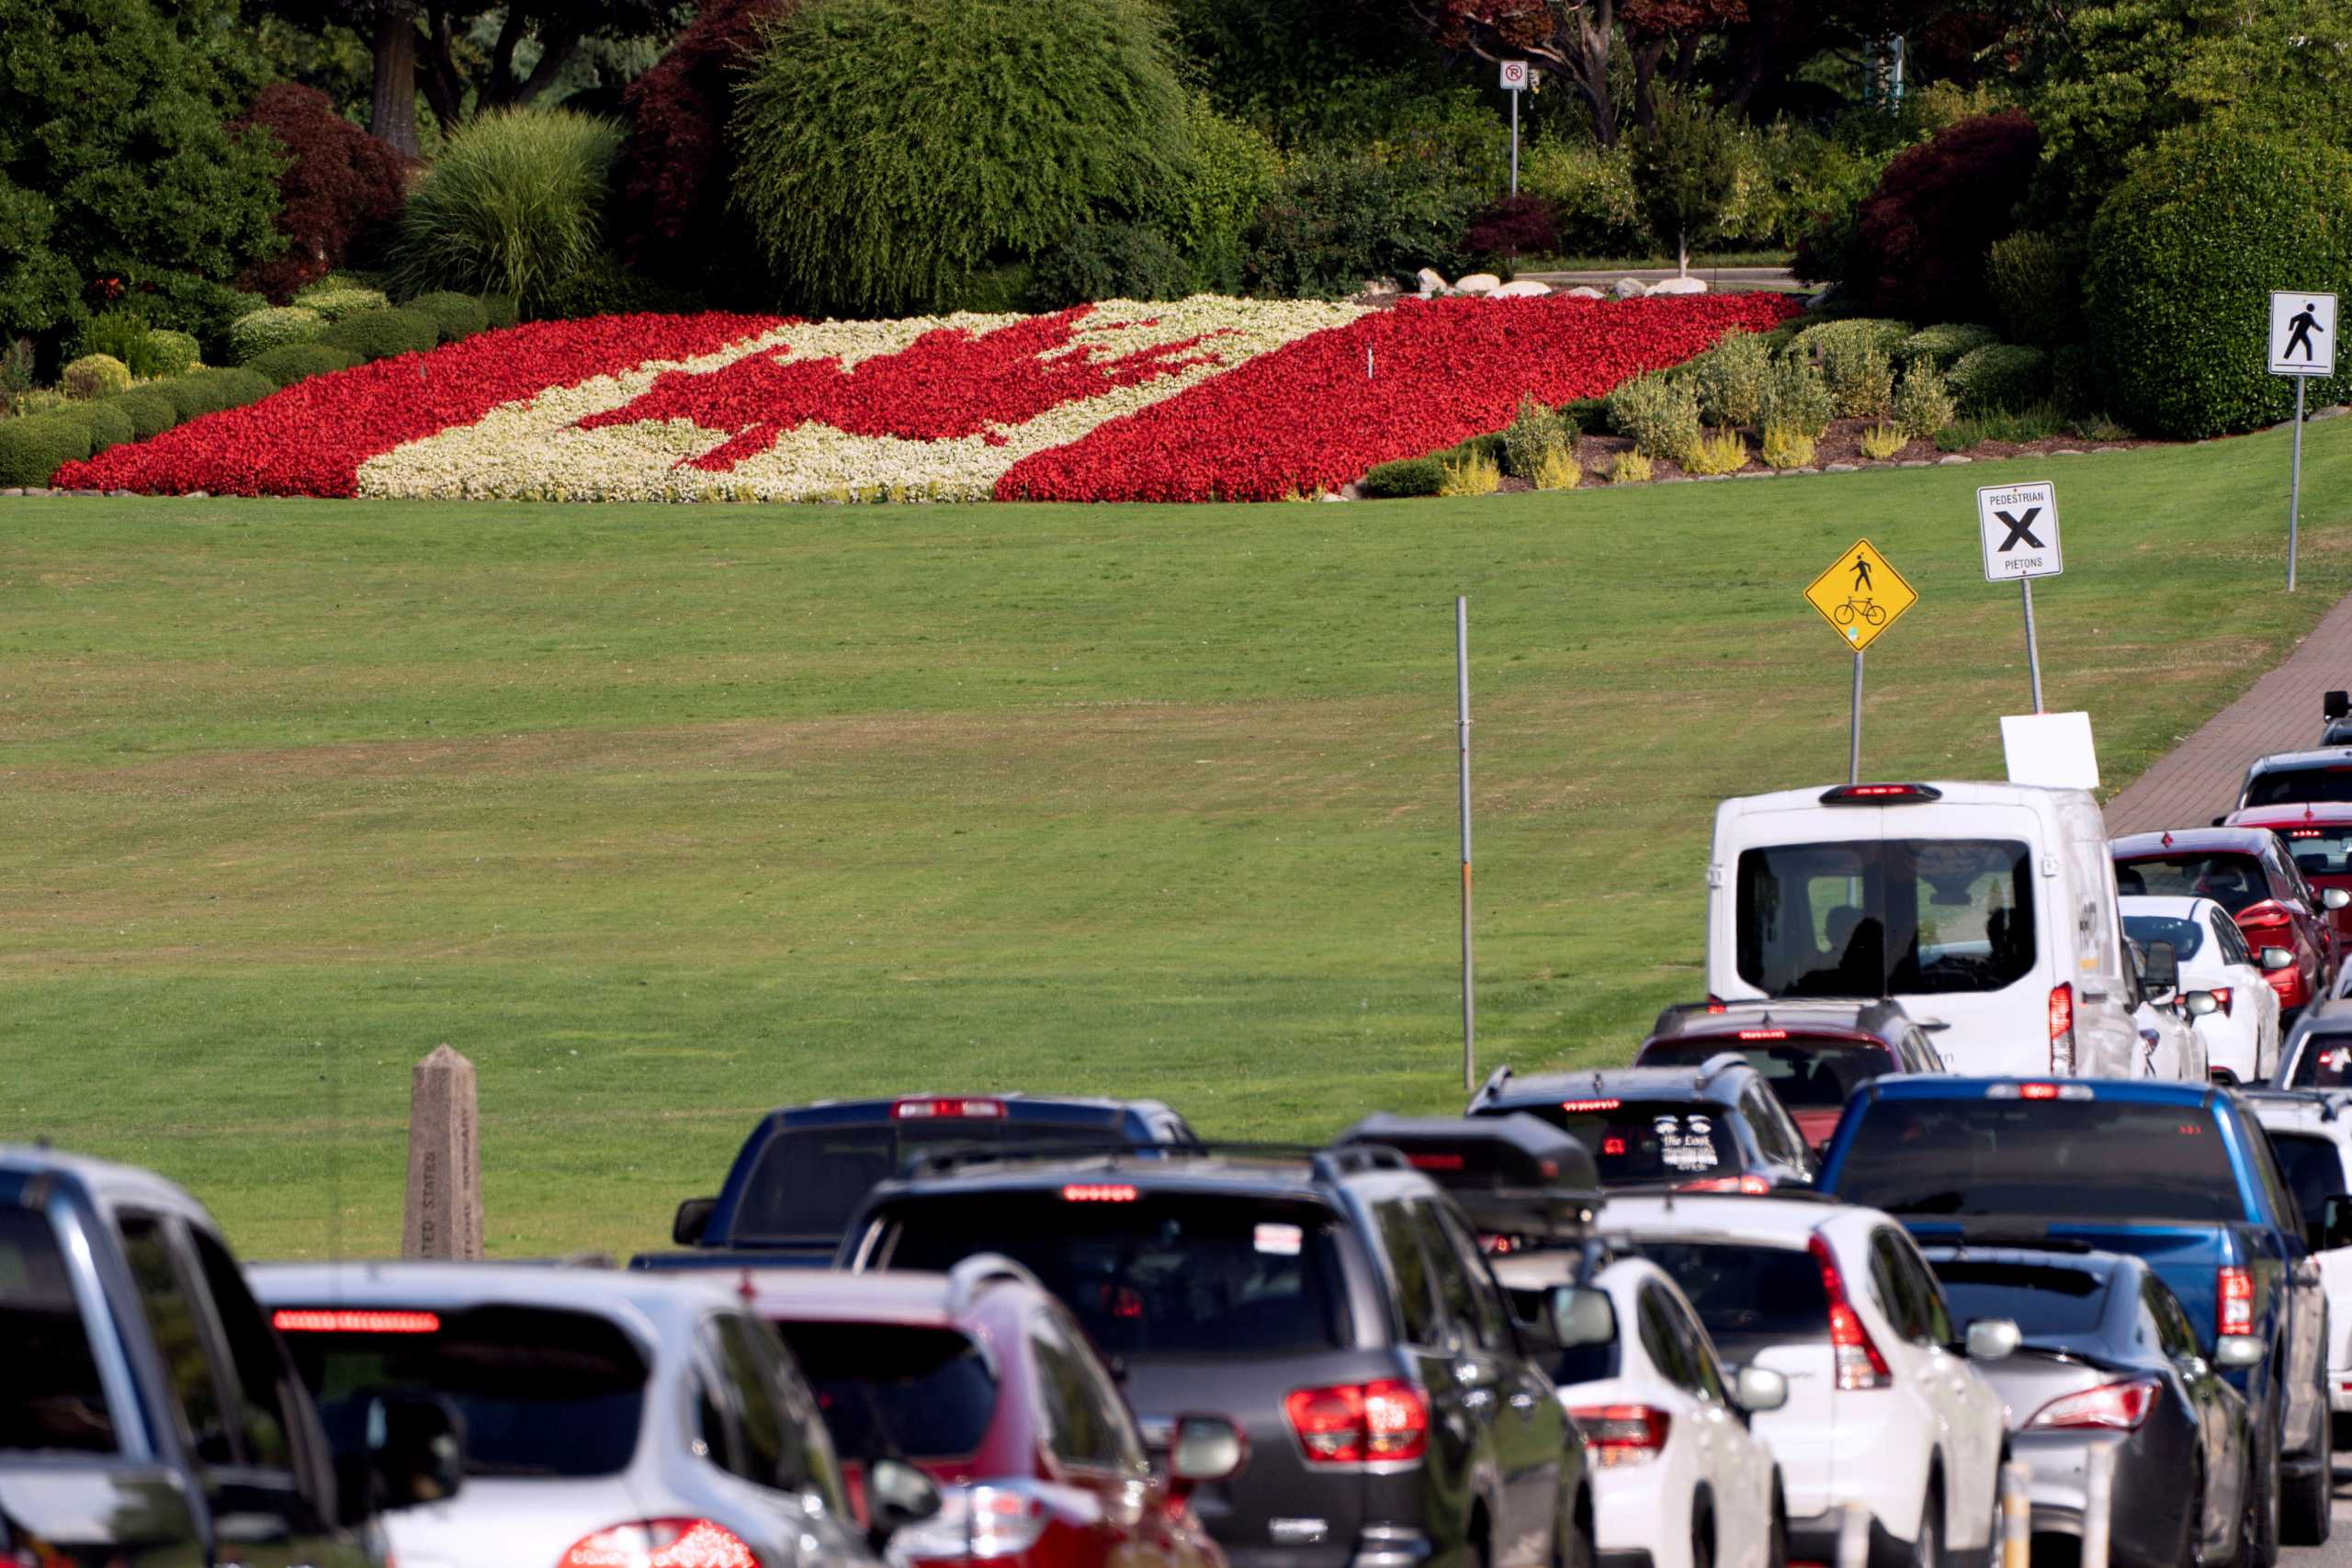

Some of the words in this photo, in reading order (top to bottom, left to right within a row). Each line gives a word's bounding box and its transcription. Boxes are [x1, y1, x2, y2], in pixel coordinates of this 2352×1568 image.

[1989, 491, 2044, 505] PEDESTRIAN
[1993, 507, 2046, 552] X
[2005, 558, 2042, 570] PIETONS
[423, 1152, 435, 1210] STATES
